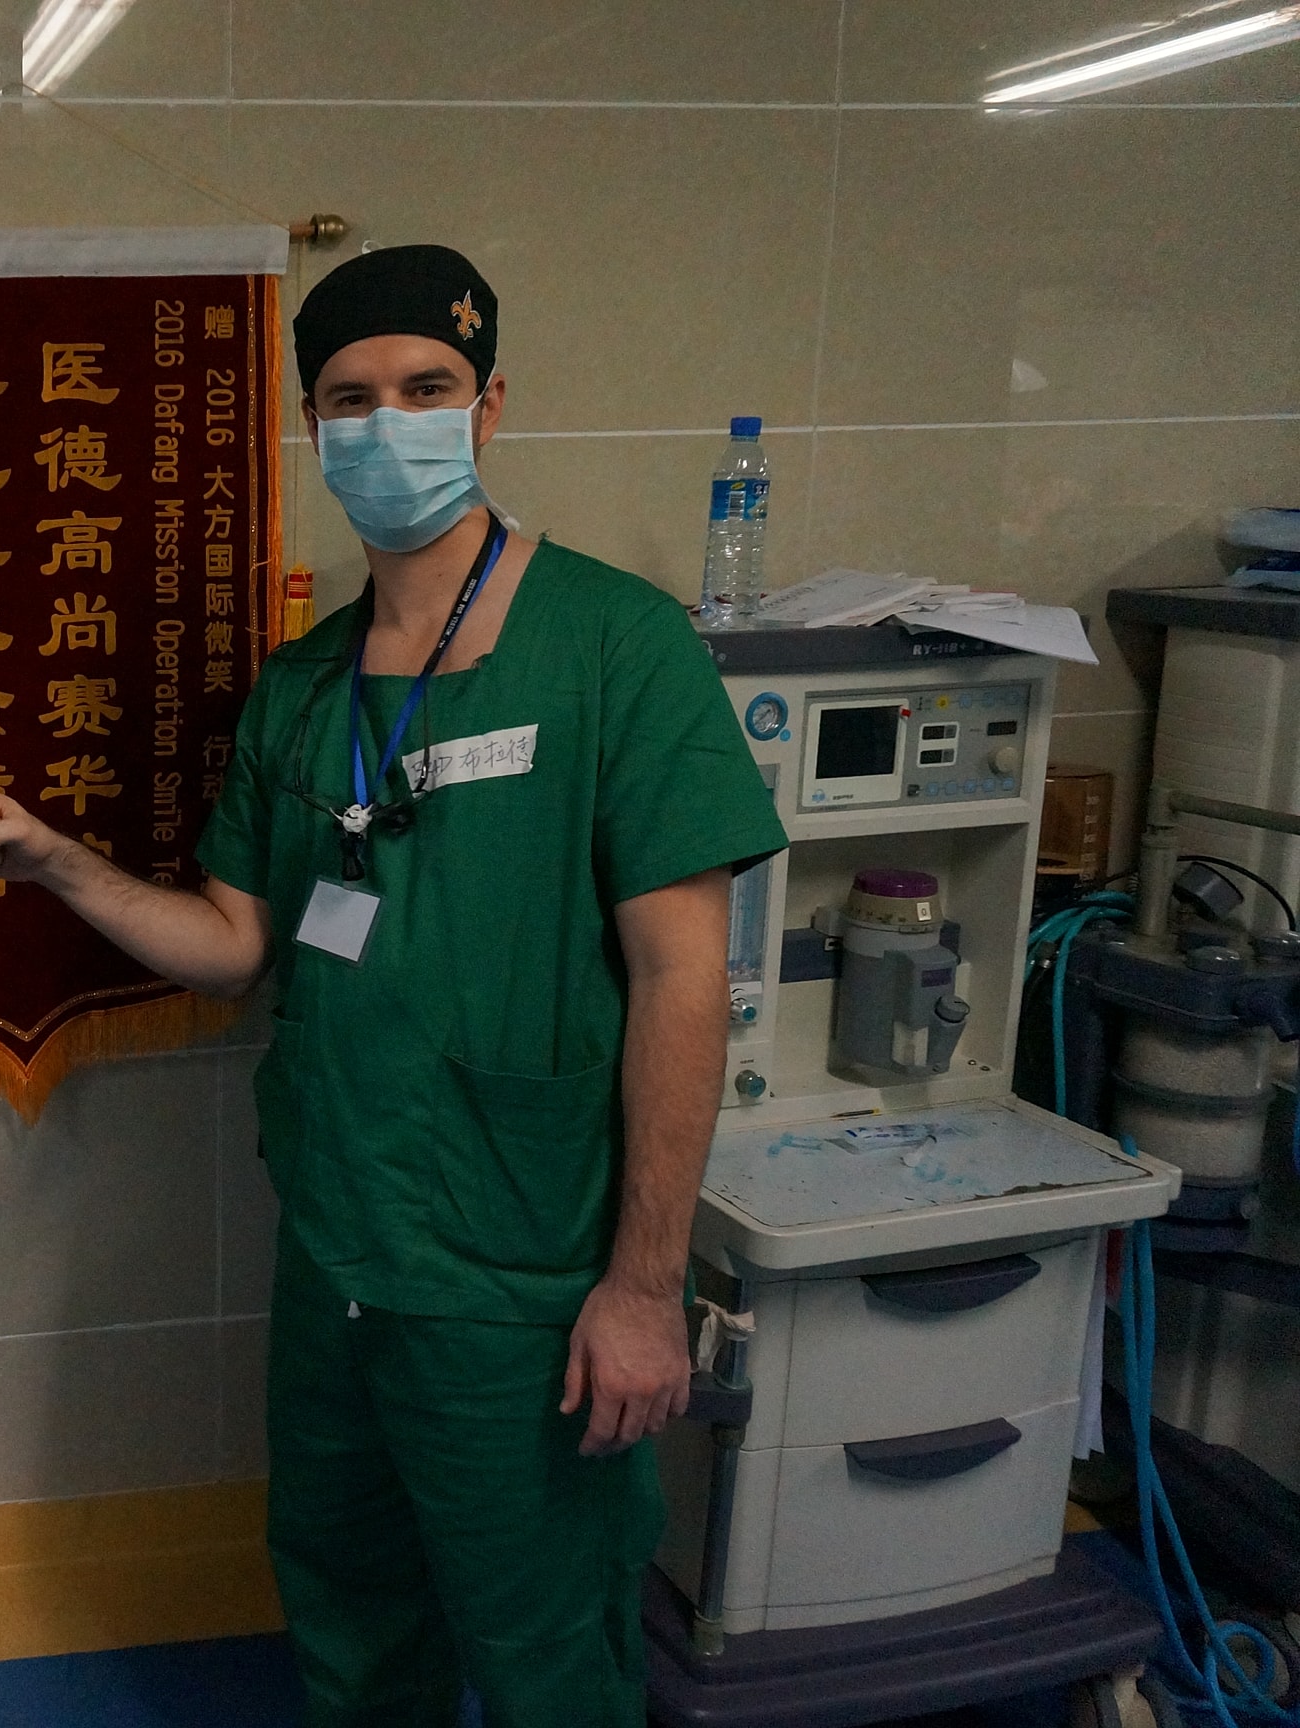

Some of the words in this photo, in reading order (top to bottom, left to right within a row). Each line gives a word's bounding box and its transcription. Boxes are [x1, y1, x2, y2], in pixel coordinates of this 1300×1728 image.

[155, 300, 185, 367] 2016
[204, 304, 235, 340] 赠
[152, 384, 185, 483] Dafang
[206, 369, 236, 446] 2016
[35, 342, 124, 857] 医德高尚赛华
[155, 499, 185, 604] Mission
[203, 465, 234, 693] 大方国际微笑
[153, 620, 186, 756] Operation
[153, 772, 182, 842] Smile
